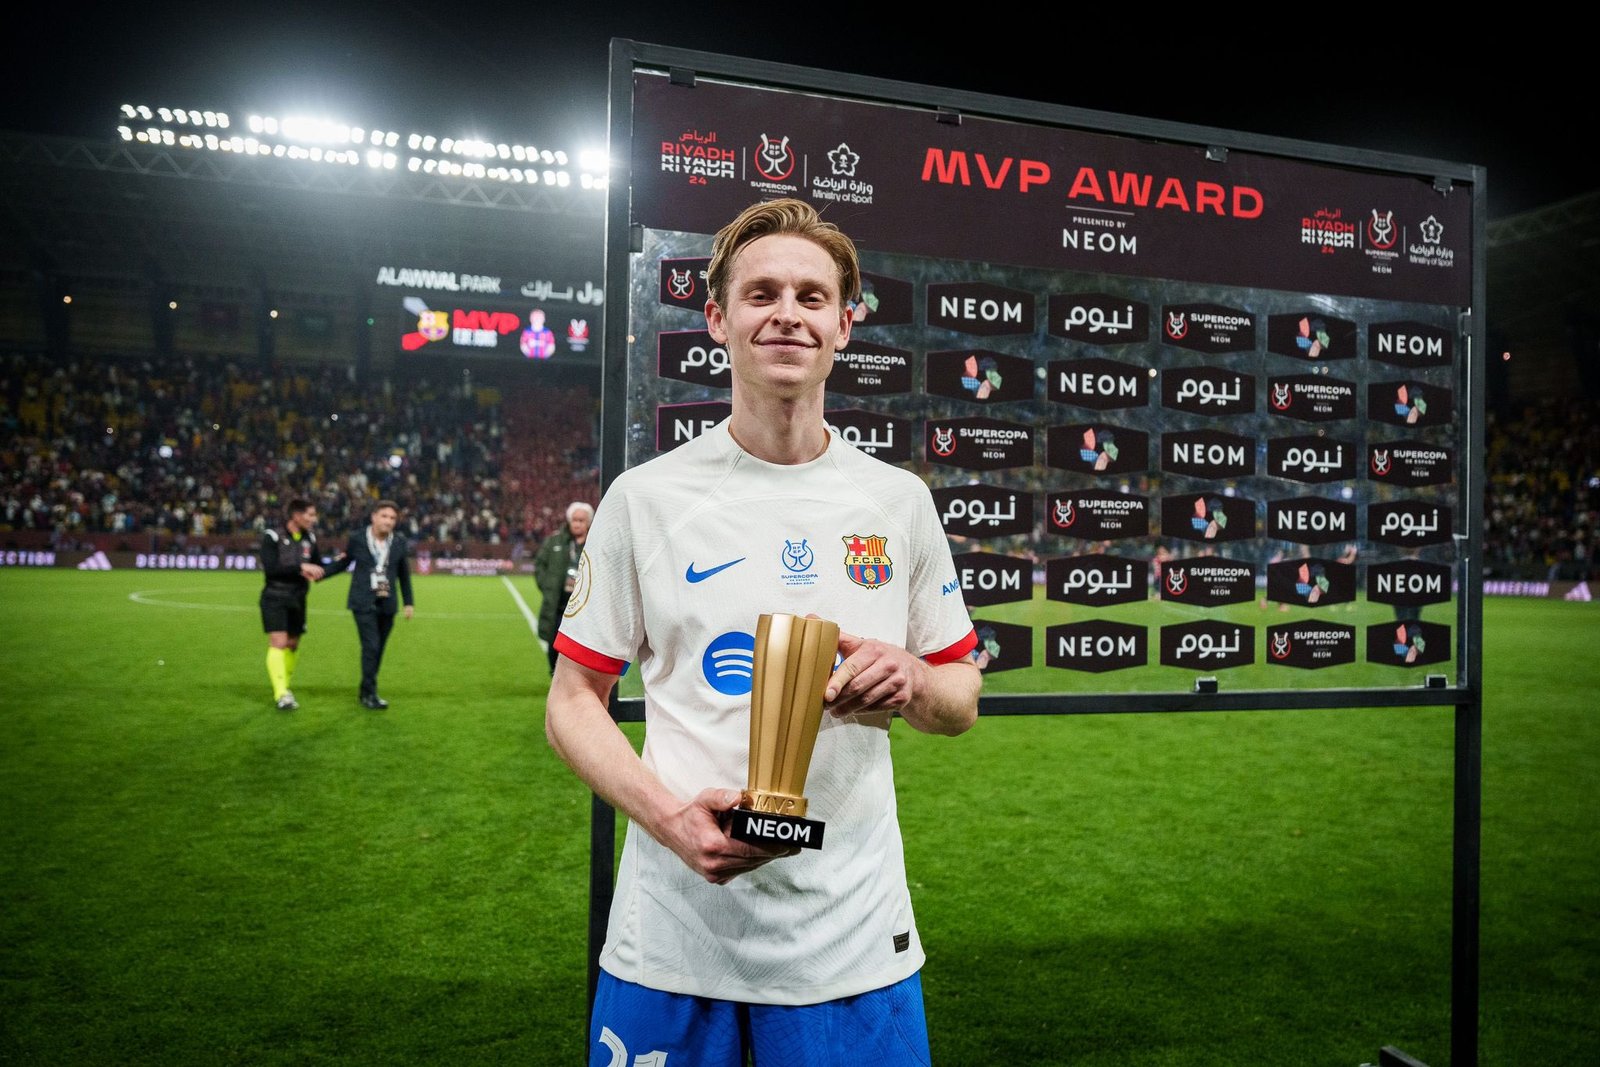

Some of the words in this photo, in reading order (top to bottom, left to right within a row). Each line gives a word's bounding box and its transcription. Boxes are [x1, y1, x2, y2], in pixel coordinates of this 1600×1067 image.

[661, 141, 735, 162] RIYADH
[689, 175, 707, 186] 24
[750, 181, 798, 192] SUPERCOPA
[812, 176, 847, 192] الرياضة
[849, 179, 874, 196] وزارة
[921, 147, 1051, 193] MVP
[1068, 166, 1264, 219] AWARD
[812, 189, 841, 202] Ministry
[841, 193, 851, 202] of
[851, 193, 873, 205] Sport
[1073, 216, 1114, 228] PRESENTED
[1117, 221, 1126, 229] BY
[1302, 217, 1354, 233] RIYADH
[1063, 228, 1137, 255] NEOM
[1372, 265, 1392, 274] NEOM
[460, 273, 501, 294] PARK
[940, 296, 1022, 323] NEOM
[453, 308, 520, 336] MVP
[1064, 305, 1133, 334] نيوم
[1190, 312, 1251, 326] SUPERCOPA
[1210, 335, 1231, 344] NEOM
[1378, 332, 1443, 357] NEOM
[680, 346, 731, 375] وم
[834, 352, 906, 366] SUPERCOPA
[861, 363, 890, 371] ESPAÑA
[857, 376, 881, 385] NEOM
[1060, 371, 1137, 397] NEOM
[1177, 377, 1241, 406] نيوم
[1294, 383, 1351, 396] SUPERCOPA
[1313, 405, 1333, 413] NEOM
[960, 427, 1029, 440] SUPERCOPA
[982, 451, 1006, 460] NEOM
[1173, 442, 1245, 466] NEOM
[1282, 445, 1342, 473] نيوم
[1393, 449, 1447, 460] SUPERCOPA
[943, 495, 1016, 526] نيوم
[1078, 499, 1144, 510] SUPERCOPA
[1100, 521, 1122, 529] NEOM
[1278, 510, 1345, 532] NEOM
[1380, 509, 1438, 536] نيوم
[135, 553, 219, 570] DESIGNED
[225, 554, 257, 570] FOR
[852, 556, 885, 565] F.C.B.
[962, 568, 1020, 591] EOM
[1063, 564, 1132, 595] نيوم
[1190, 567, 1251, 577] SUPERCOPA
[1210, 588, 1231, 596] NEOM
[1377, 574, 1441, 593] NEOM
[1176, 629, 1240, 659] نيوم
[1293, 631, 1351, 640] SUPERCOPA
[1059, 636, 1136, 657] NEOM
[1312, 651, 1332, 659] NEOM
[754, 794, 796, 816] MVP
[746, 817, 811, 843] NEOM
